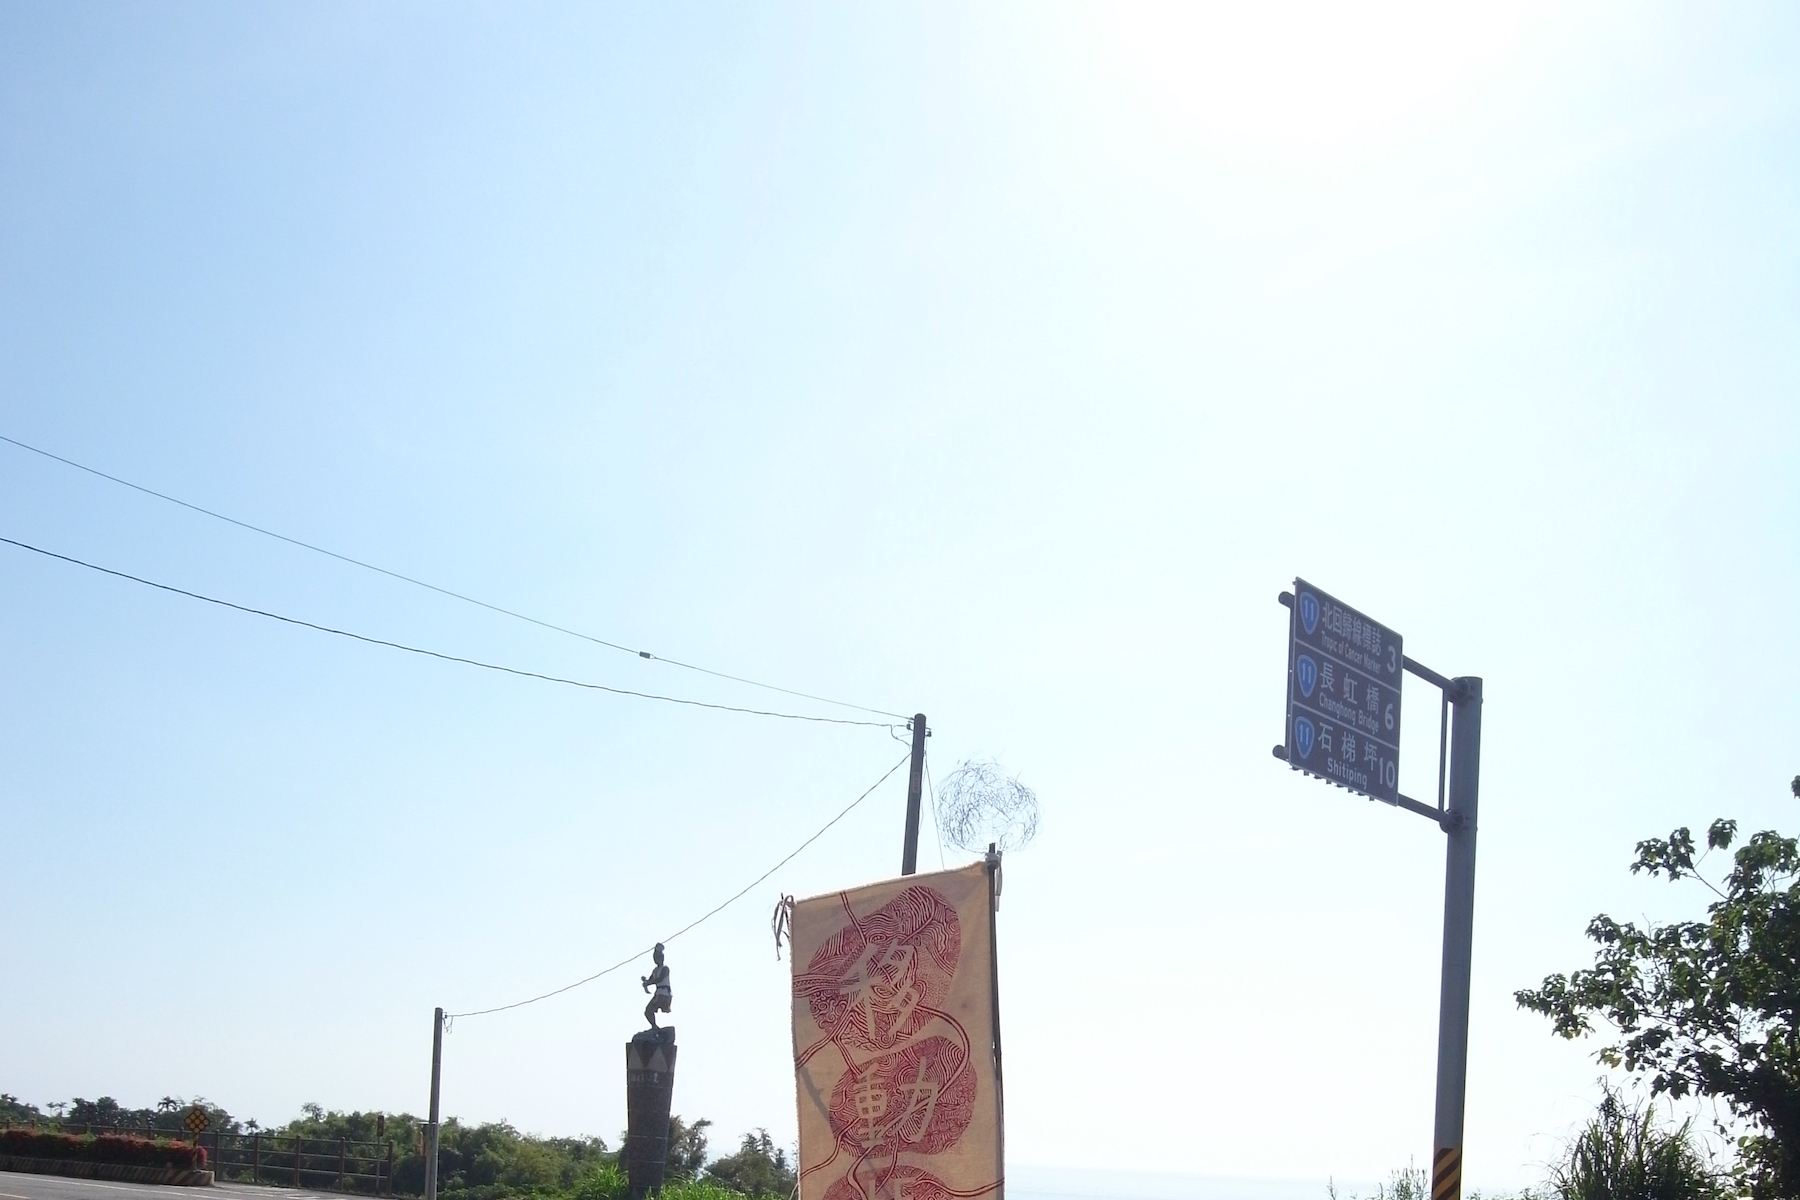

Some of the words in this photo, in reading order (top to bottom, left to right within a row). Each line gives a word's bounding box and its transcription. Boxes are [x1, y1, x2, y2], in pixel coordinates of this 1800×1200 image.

[1304, 599, 1314, 621] 11
[1322, 601, 1381, 656] 北回歸線標誌
[1321, 631, 1337, 653] Tropic
[1338, 641, 1344, 654] of
[1345, 643, 1363, 664] Cancer
[1363, 653, 1380, 675] Marker
[1387, 645, 1396, 673] 3
[1302, 662, 1312, 684] 11
[1320, 662, 1379, 714] 長虹橋
[1319, 691, 1356, 725] Changhong
[1358, 710, 1379, 735] Bridge
[1384, 703, 1394, 731] 6
[1300, 724, 1309, 746] 11
[1318, 722, 1377, 771] 石梯坪
[1327, 757, 1367, 790] Shitiping
[1379, 757, 1395, 789] 10
